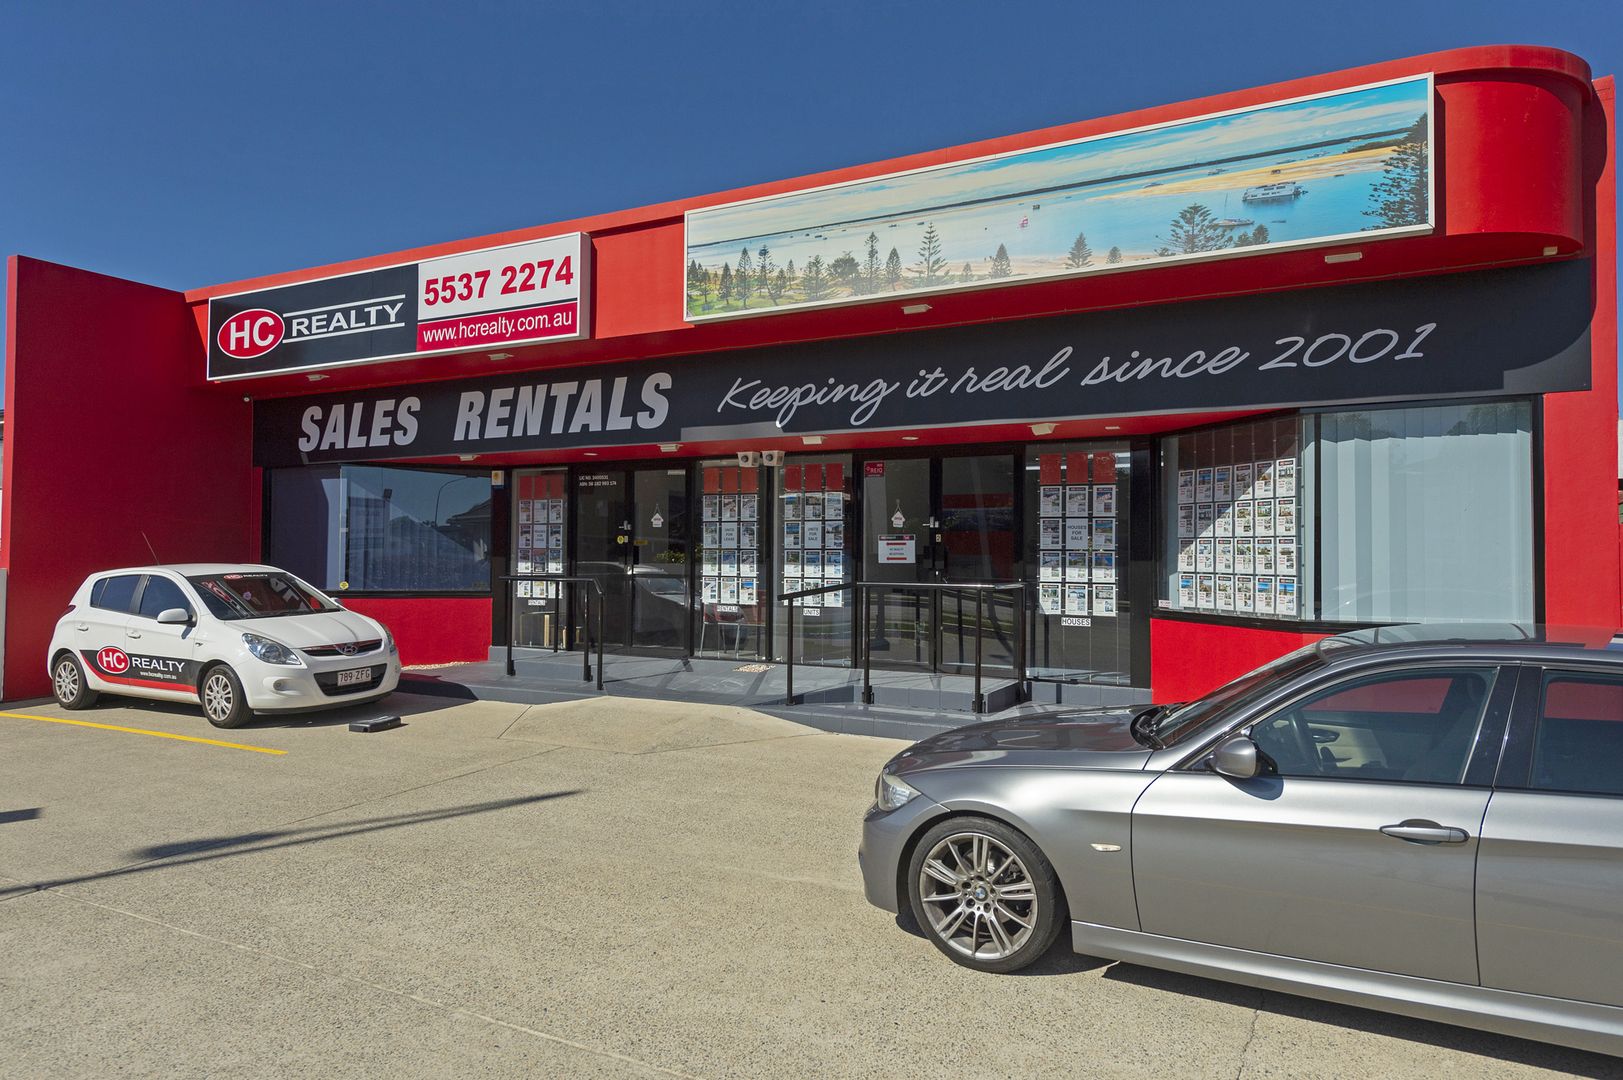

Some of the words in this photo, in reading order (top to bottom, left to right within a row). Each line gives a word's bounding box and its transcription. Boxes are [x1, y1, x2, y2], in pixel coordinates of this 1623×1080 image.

[424, 270, 491, 306] 5537
[501, 256, 574, 295] 2274
[229, 316, 275, 351] HC
[292, 303, 404, 337] REALTY
[423, 311, 572, 342] www.hcrealty.com.au
[717, 378, 900, 427] Keeping
[906, 367, 948, 398] it
[950, 346, 1073, 393] real
[1080, 346, 1250, 386] since
[1258, 322, 1436, 370] 2001
[298, 397, 420, 452] SALES
[453, 372, 672, 440] RENTALS
[1062, 618, 1090, 626] HOUSES
[102, 651, 125, 669] HC
[132, 657, 185, 673] REALTY
